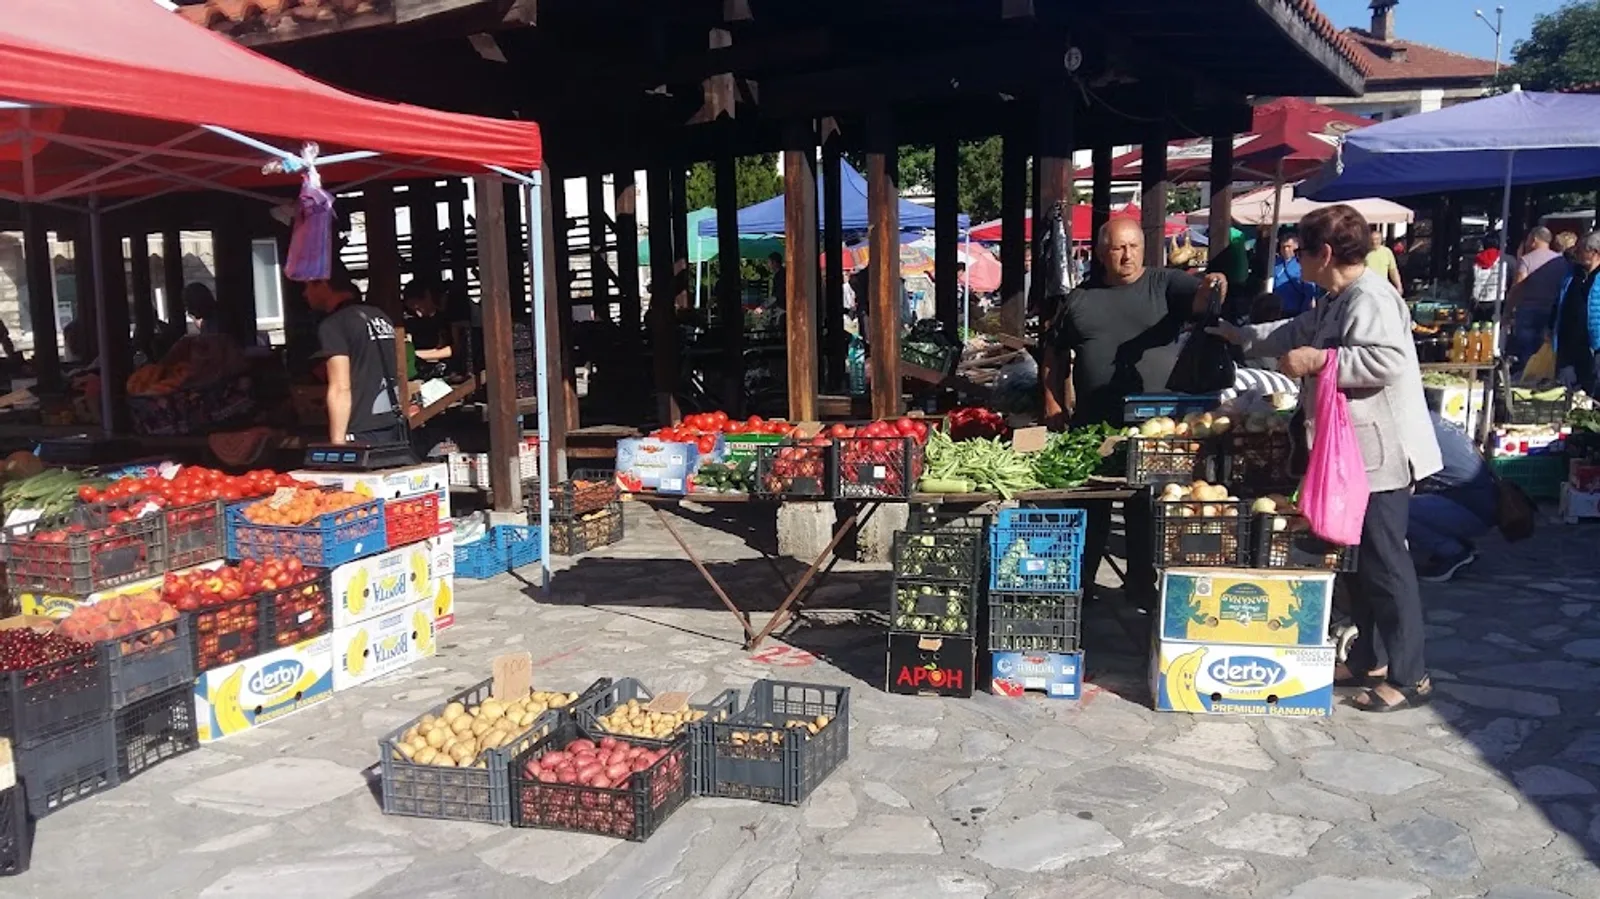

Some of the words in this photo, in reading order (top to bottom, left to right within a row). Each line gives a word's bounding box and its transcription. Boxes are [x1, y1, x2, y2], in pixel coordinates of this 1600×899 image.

[372, 573, 406, 603] BONITA
[1221, 593, 1270, 605] BANANAS
[372, 632, 408, 663] BONITA
[252, 663, 300, 692] derby
[1213, 656, 1282, 685] derby
[1211, 704, 1266, 714] PREMIUM
[1269, 705, 1326, 717] BANANAS
